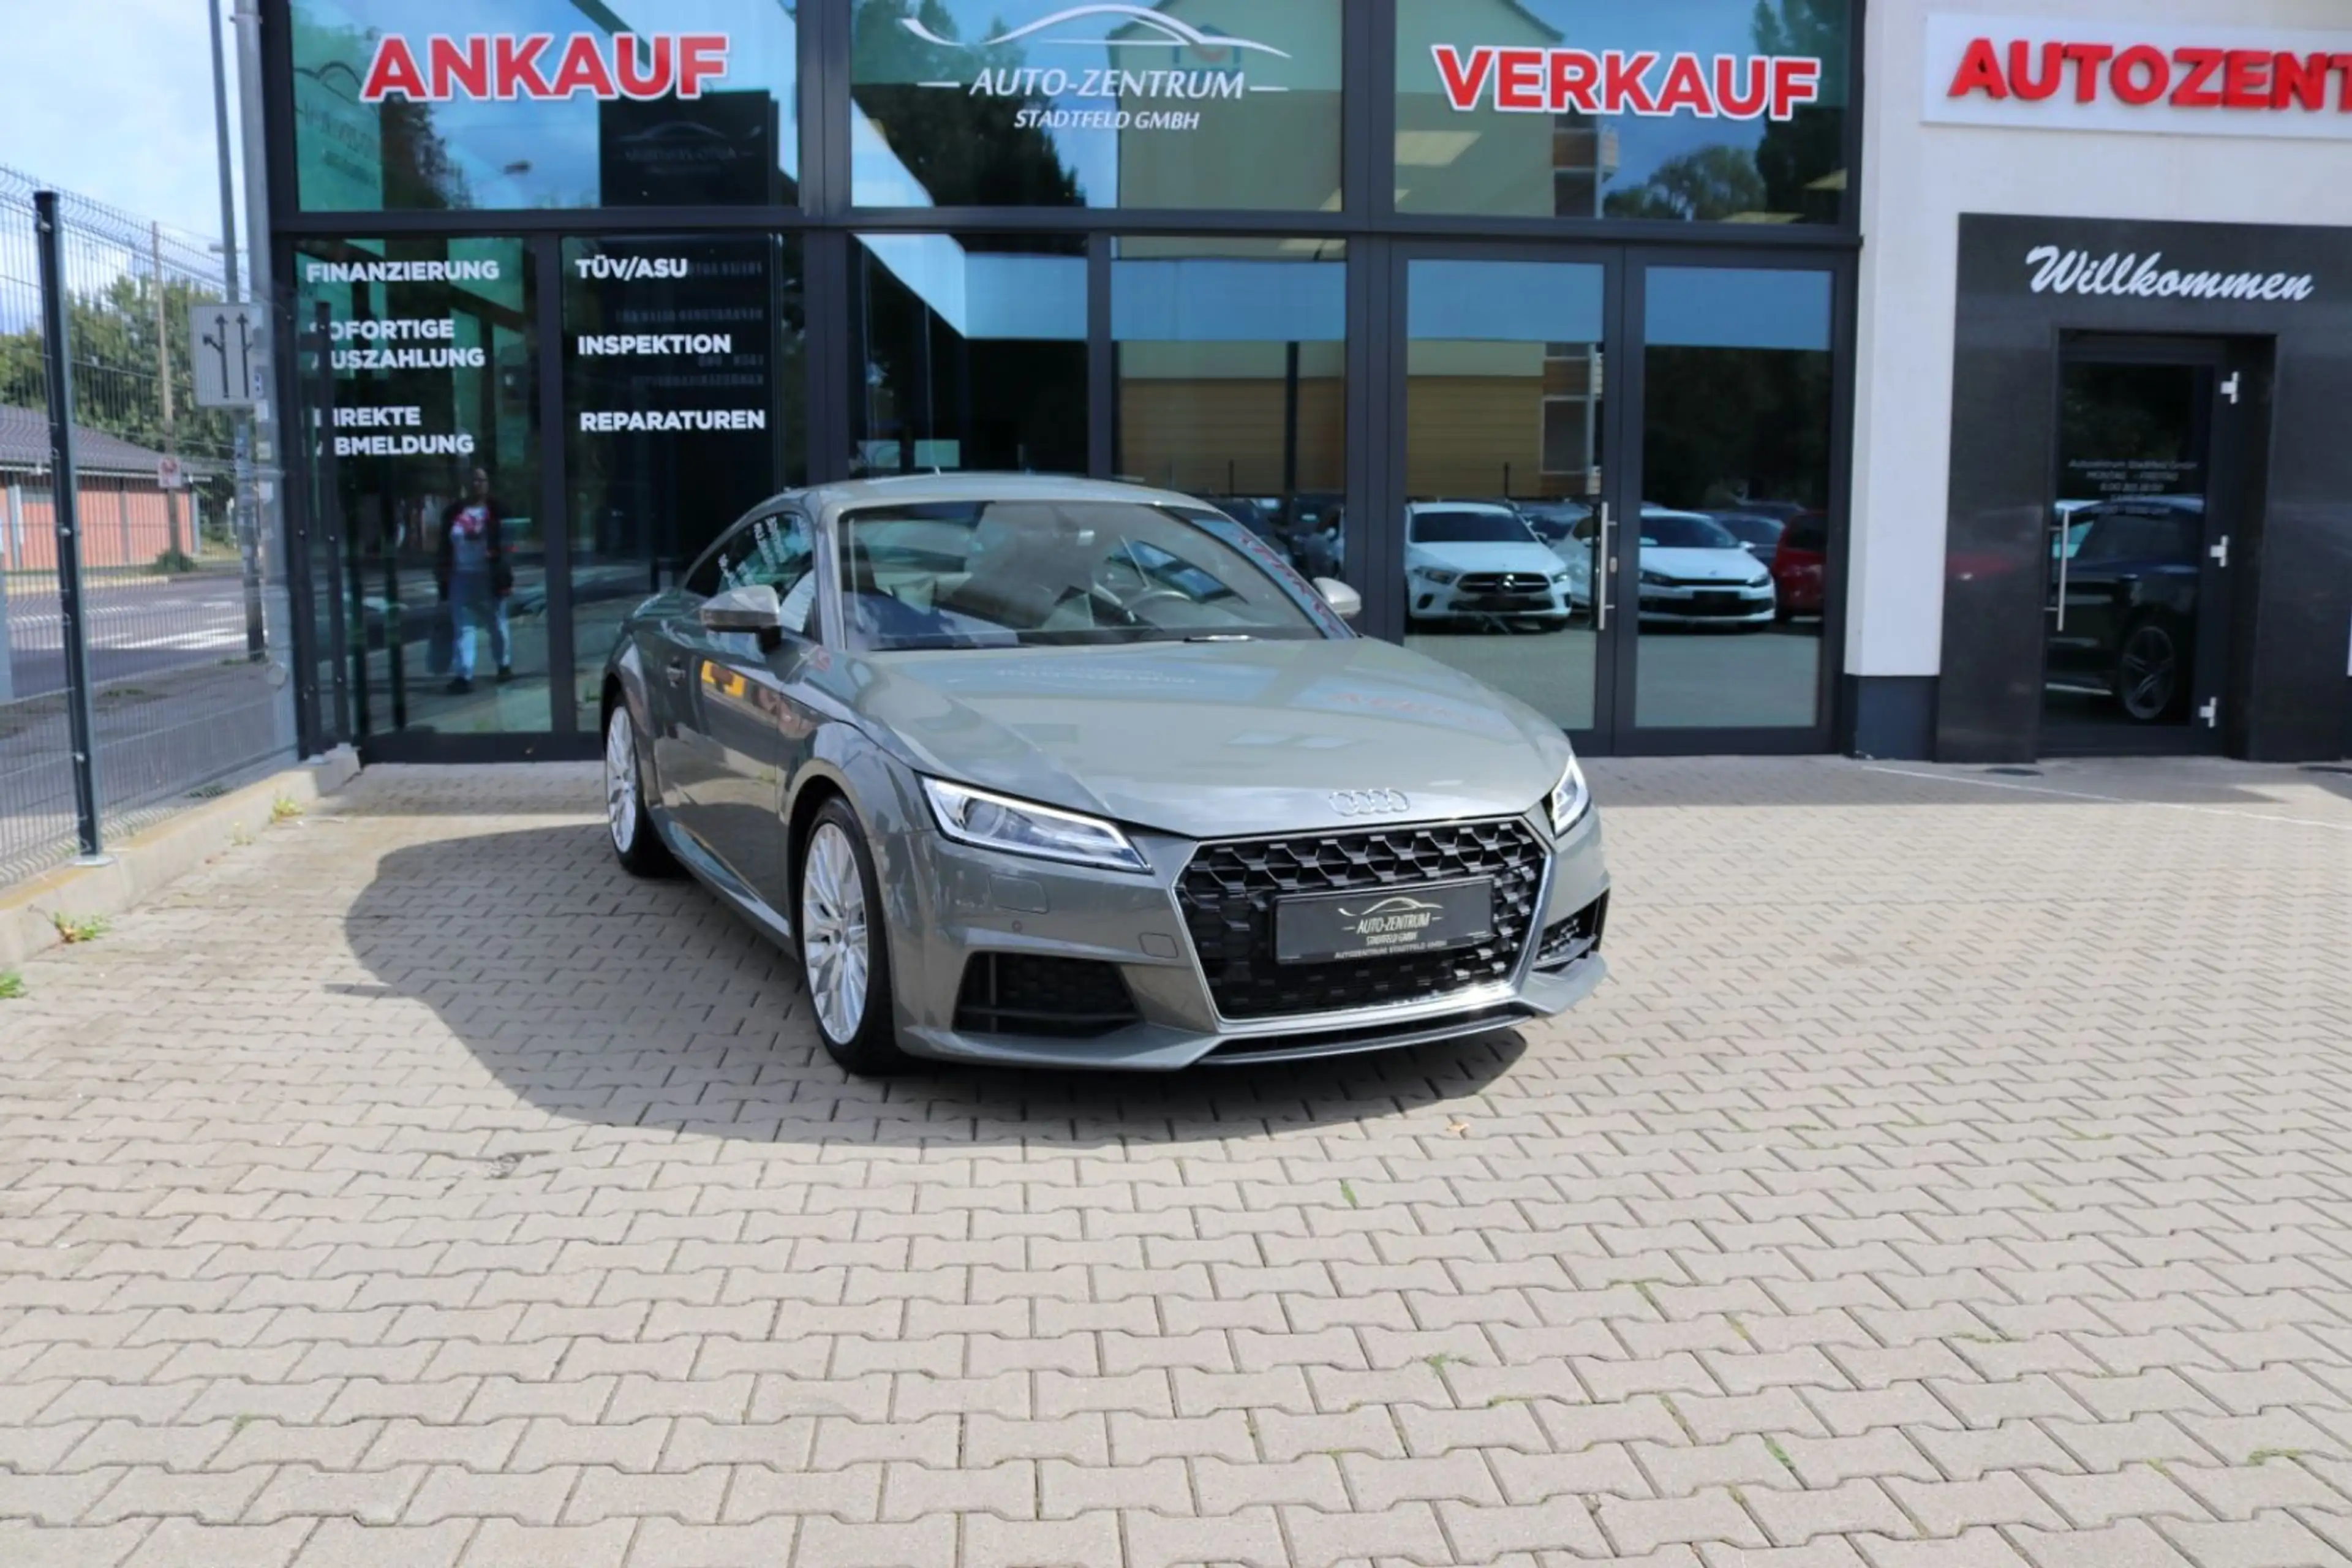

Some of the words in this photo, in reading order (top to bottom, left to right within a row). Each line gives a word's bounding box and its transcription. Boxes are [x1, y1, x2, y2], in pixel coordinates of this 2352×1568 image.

[360, 32, 729, 102] ANKAUF
[968, 68, 1245, 99] AUTO-ZENTRUM
[1431, 45, 1822, 121] VERKAUF
[1014, 109, 1130, 129] STADTFELD
[1135, 111, 1200, 130] GMBH
[306, 260, 500, 282] FINANZIERUNG
[575, 255, 688, 281] TÜV/ASU
[2026, 245, 2314, 301] Willkommen
[578, 334, 731, 355] INSPEKTION
[311, 347, 486, 369] USZAHLUNG
[581, 410, 765, 431] REPARATUREN
[316, 434, 475, 456] BMELDUNG
[1356, 912, 1431, 934] AUTO-ZENTRUM
